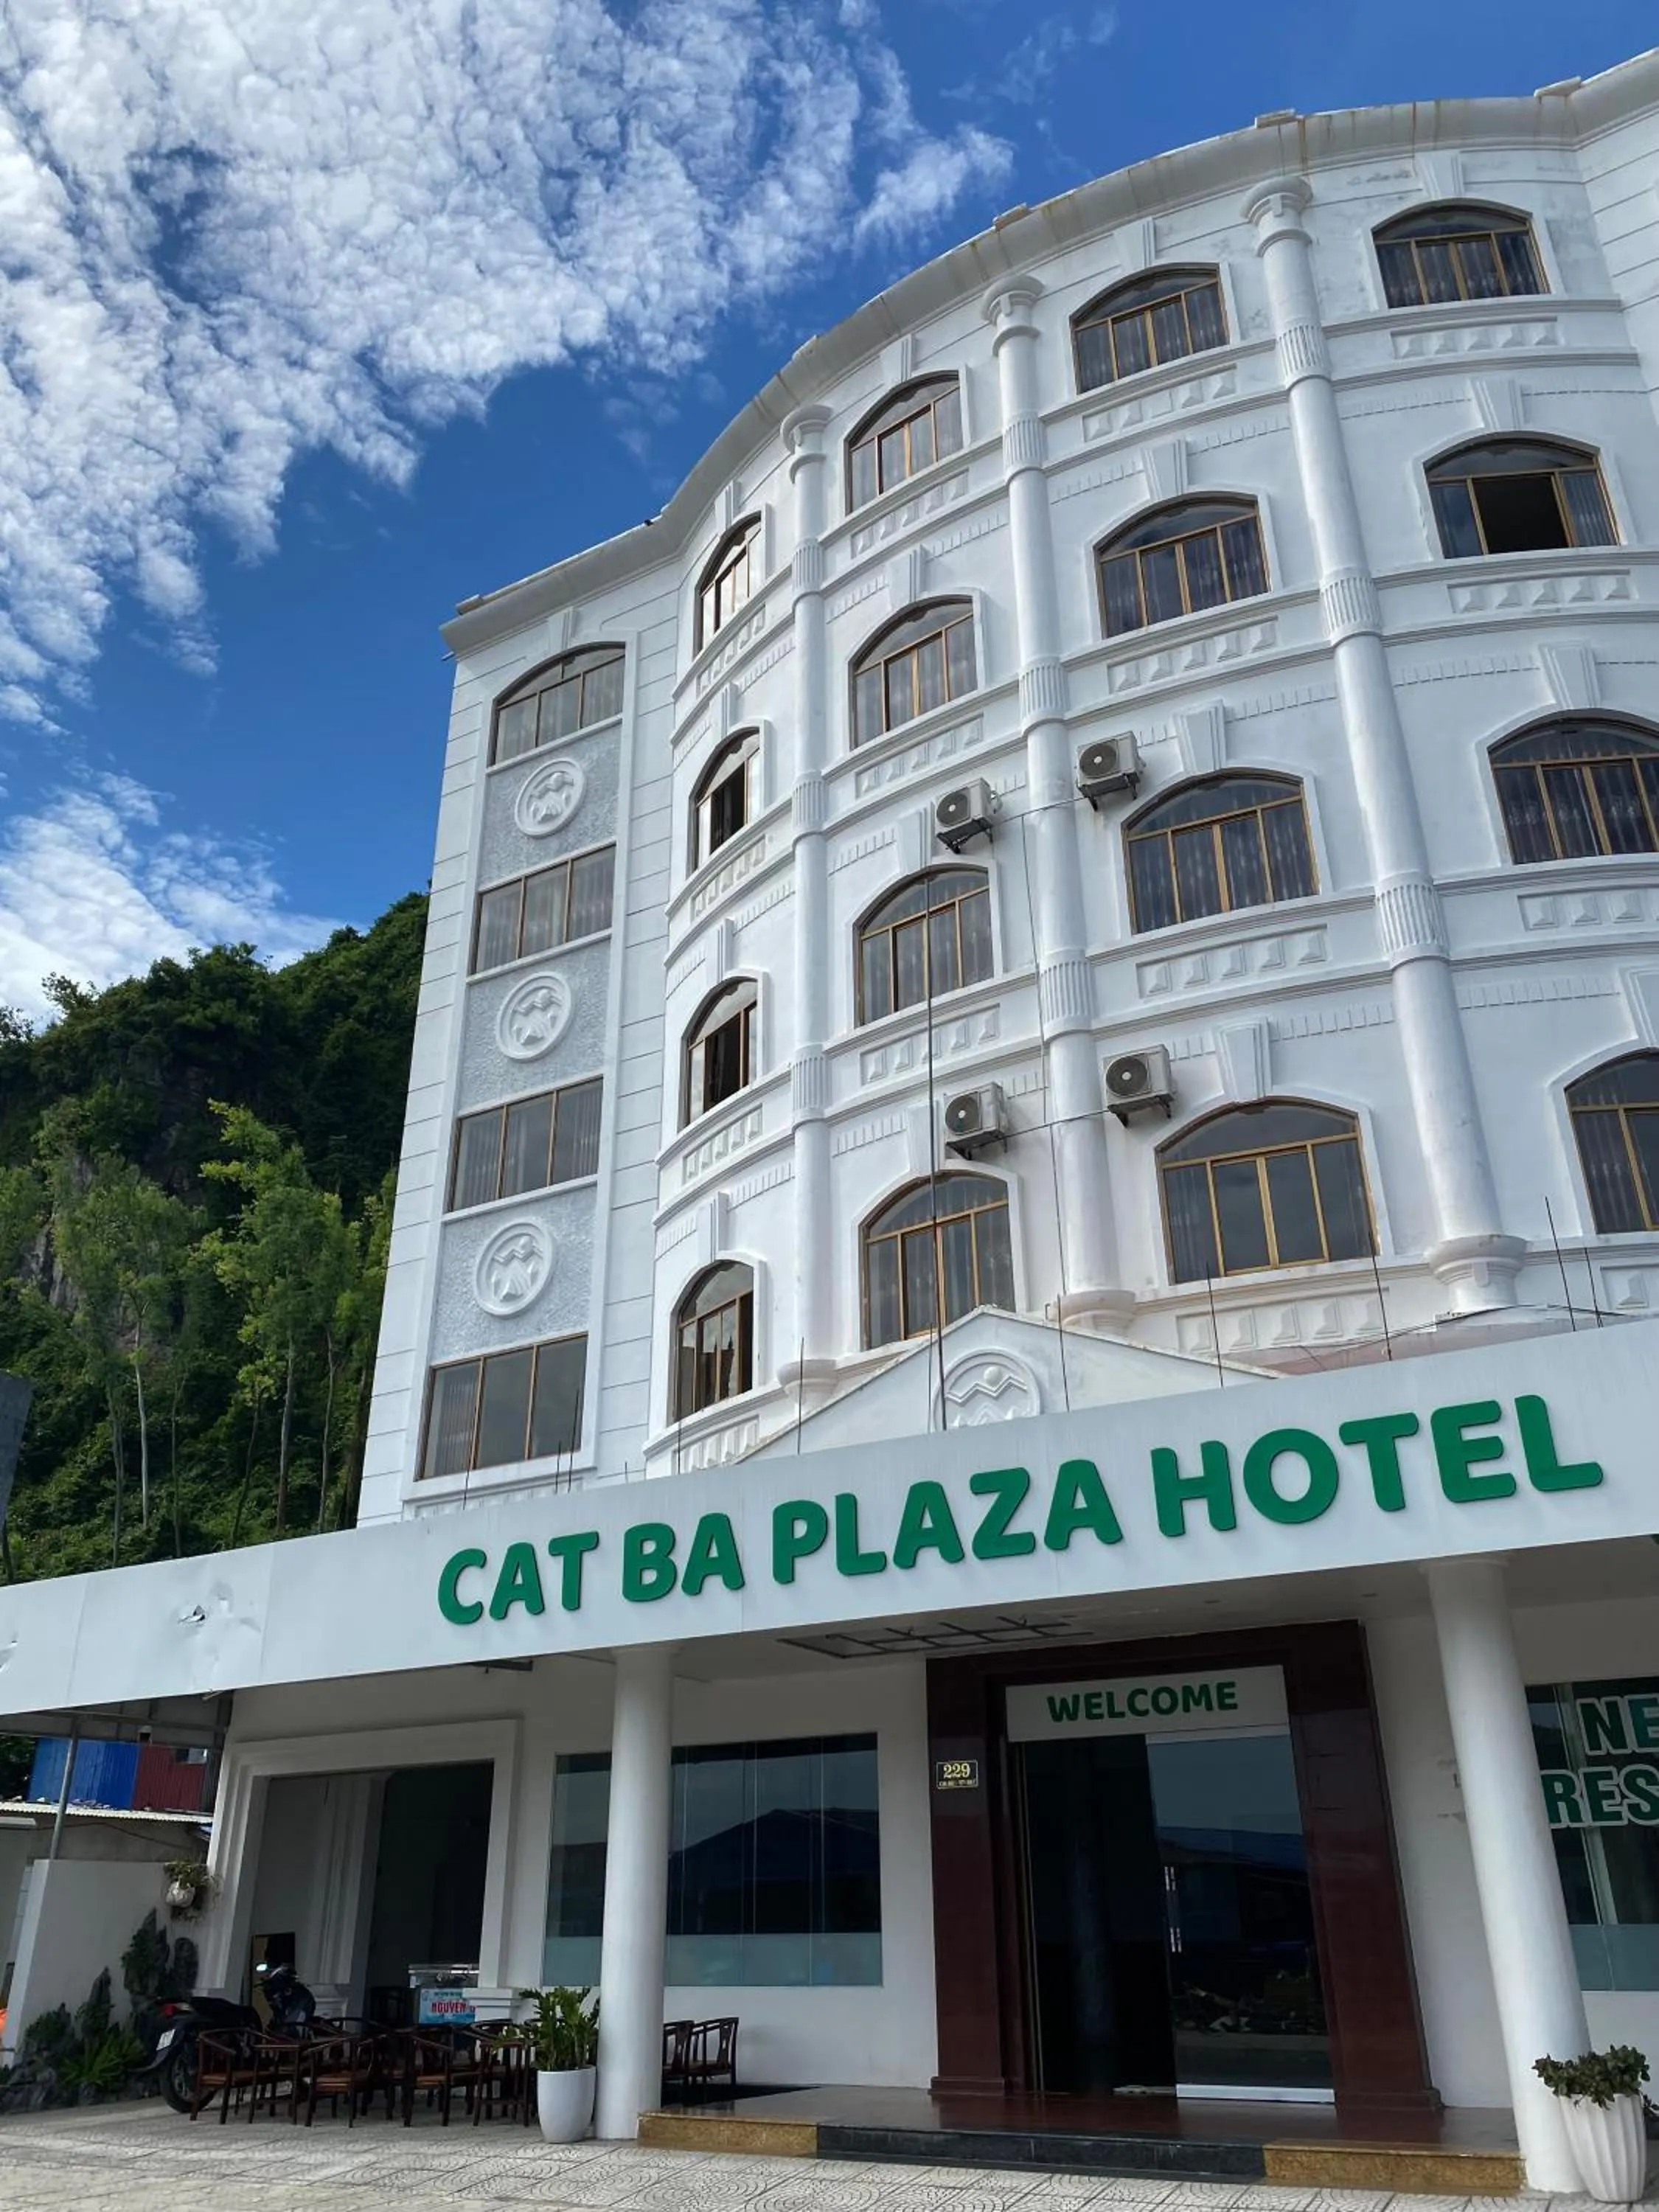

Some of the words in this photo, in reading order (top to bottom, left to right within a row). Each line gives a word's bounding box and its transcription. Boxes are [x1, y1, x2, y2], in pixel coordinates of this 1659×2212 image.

[438, 1531, 599, 1625] CAT
[622, 1512, 745, 1602] BA
[773, 1459, 1124, 1585] PLAZA
[1150, 1394, 1604, 1537] HOTEL
[1046, 1681, 1238, 1722] WELCOME
[943, 1763, 970, 1778] 229
[1540, 1763, 1659, 1828] RES
